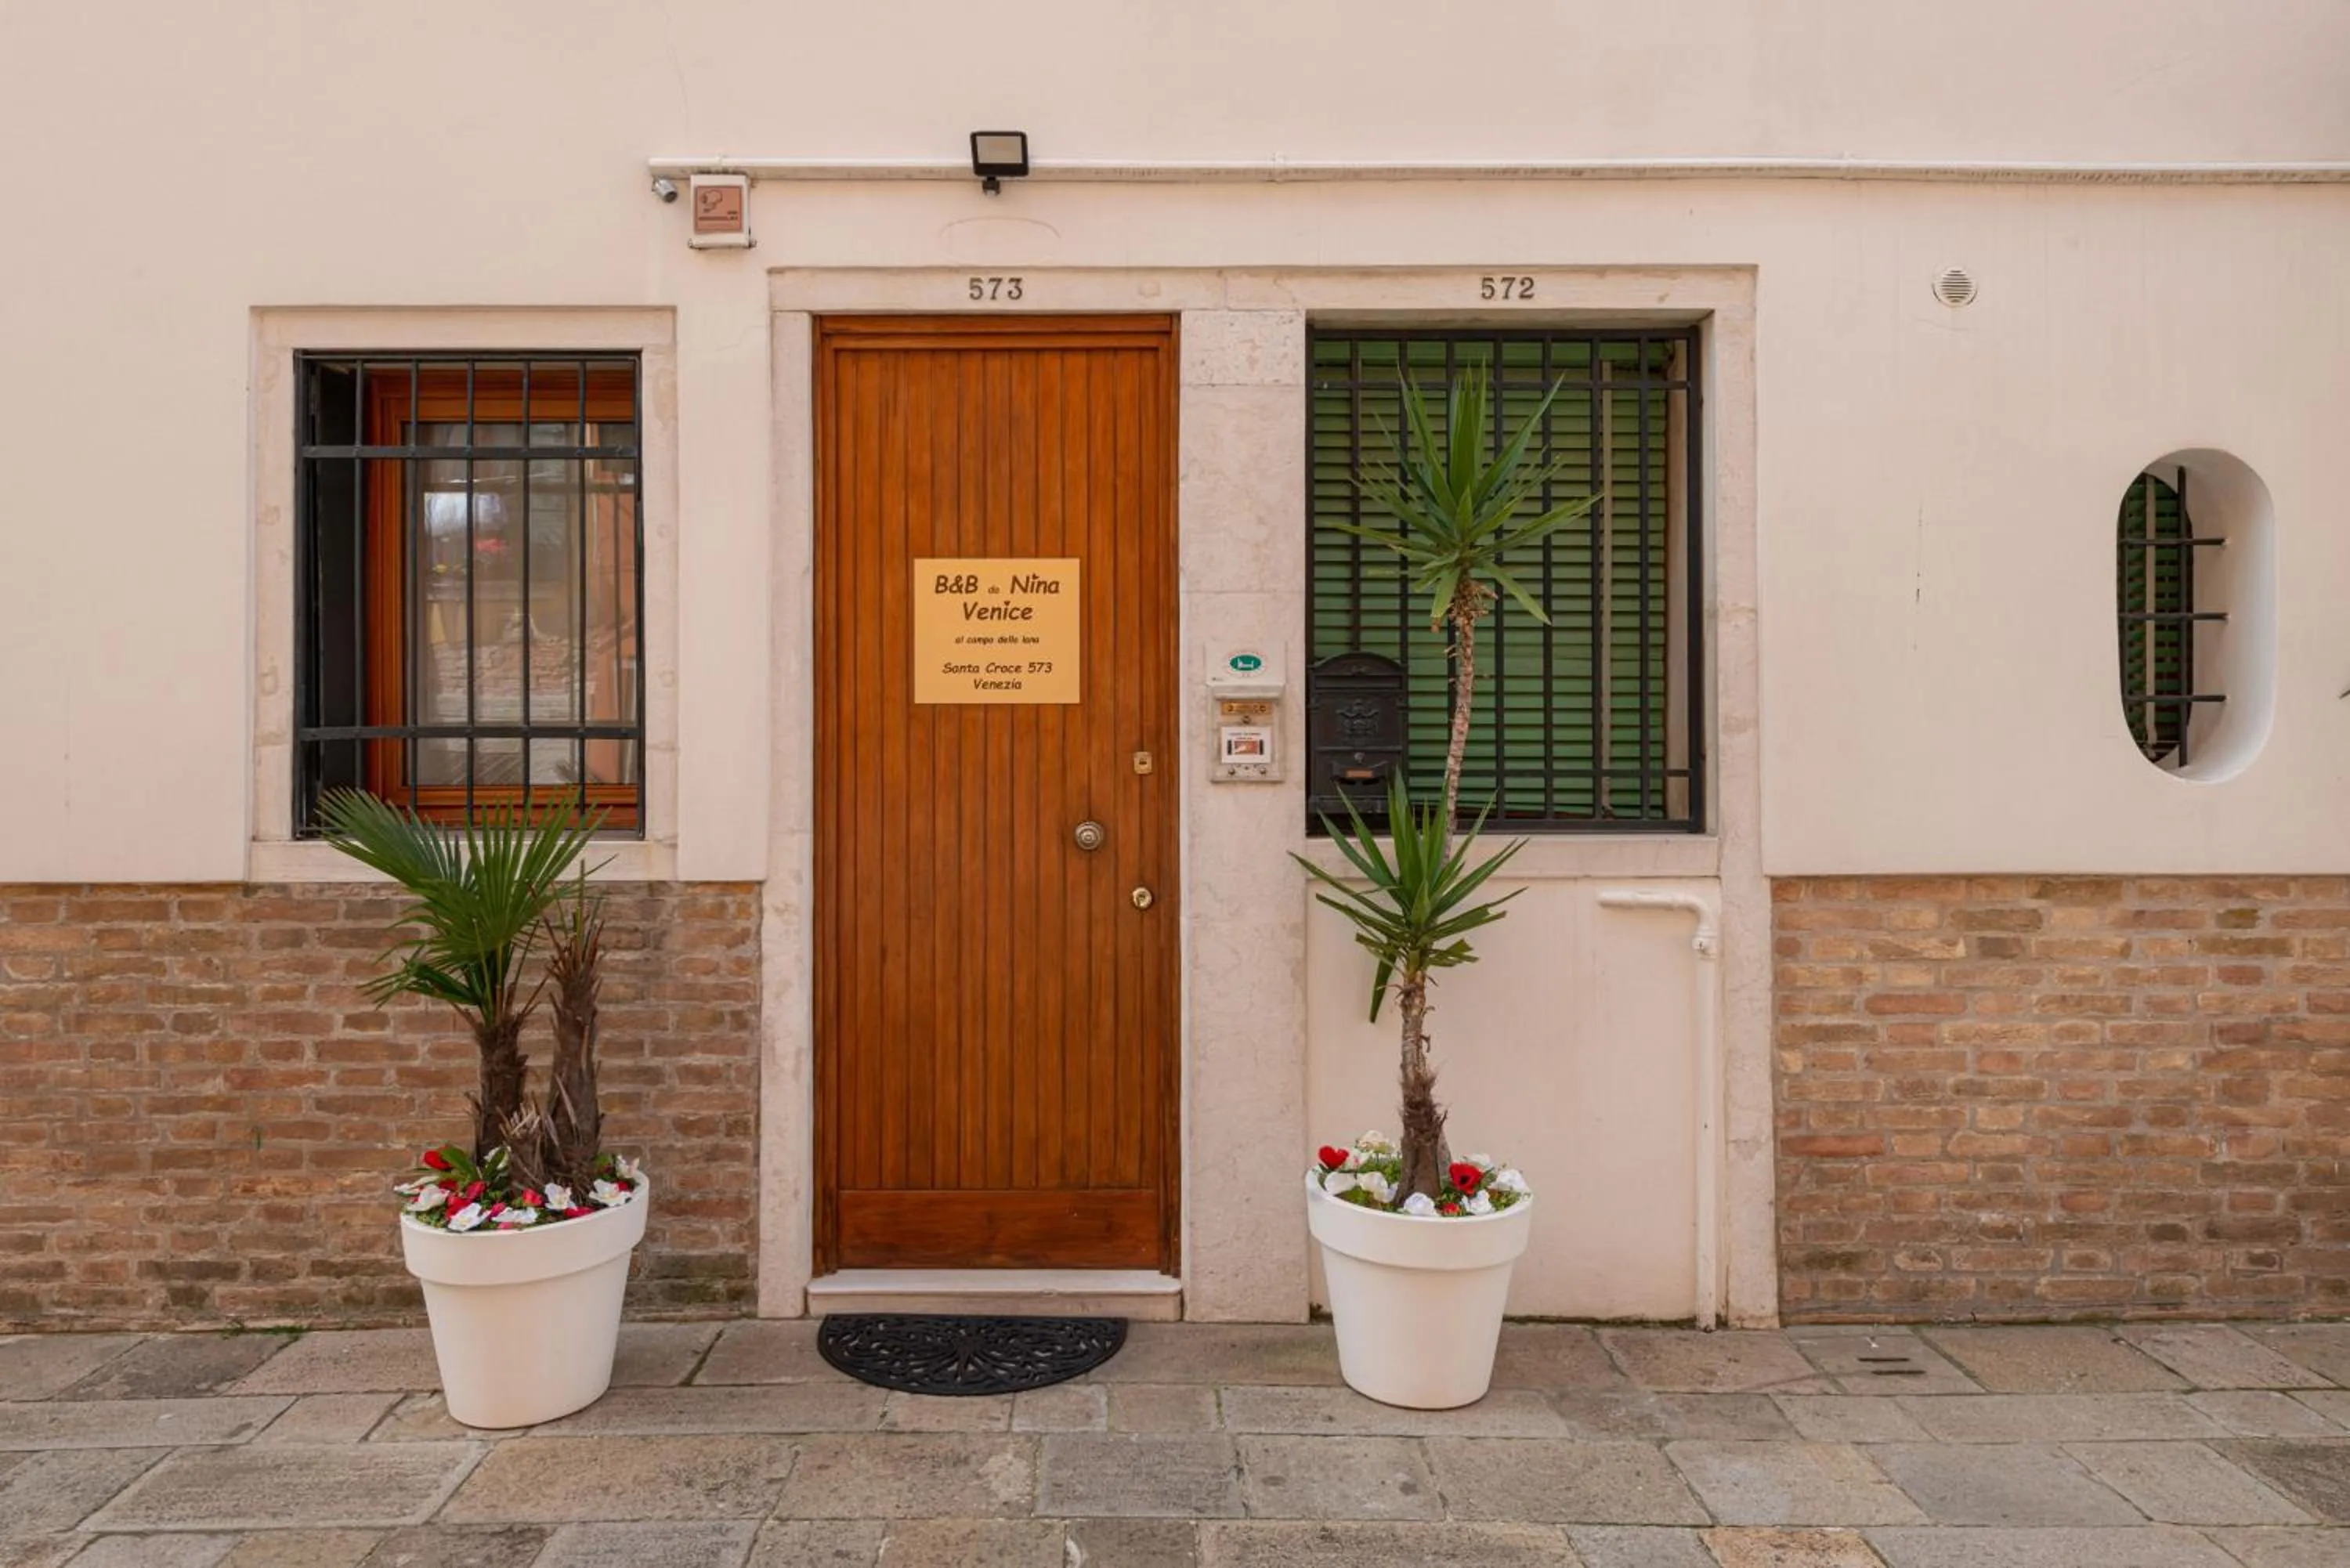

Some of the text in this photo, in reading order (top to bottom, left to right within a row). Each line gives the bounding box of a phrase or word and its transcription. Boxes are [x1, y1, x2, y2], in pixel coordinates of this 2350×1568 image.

[969, 276, 1023, 301] 573
[1480, 276, 1535, 300] 572
[935, 574, 978, 594] B&B
[1010, 573, 1061, 594] Nina
[963, 600, 1034, 621] Venice
[966, 636, 994, 645] campo
[942, 662, 1053, 674] Santa Croce 573
[974, 678, 1022, 690] Venezia
